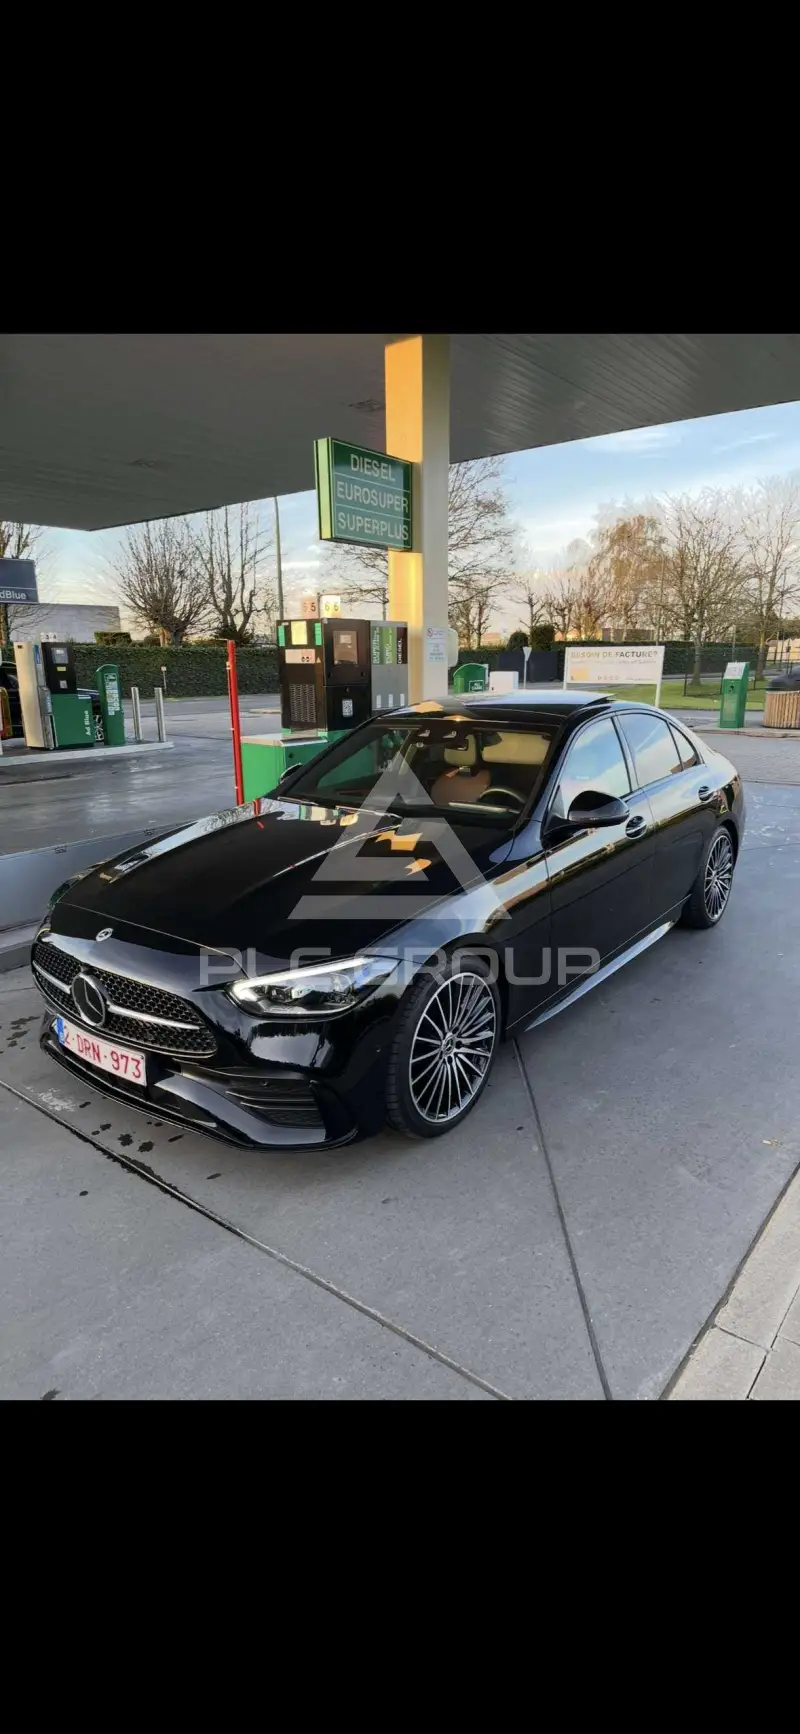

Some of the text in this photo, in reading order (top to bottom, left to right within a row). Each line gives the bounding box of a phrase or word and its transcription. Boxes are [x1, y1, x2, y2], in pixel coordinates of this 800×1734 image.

[350, 453, 396, 481] DIESEL
[336, 481, 409, 513] EUROSUPER
[338, 512, 409, 541] SUPERPLUS
[615, 650, 658, 658] FACTURE?
